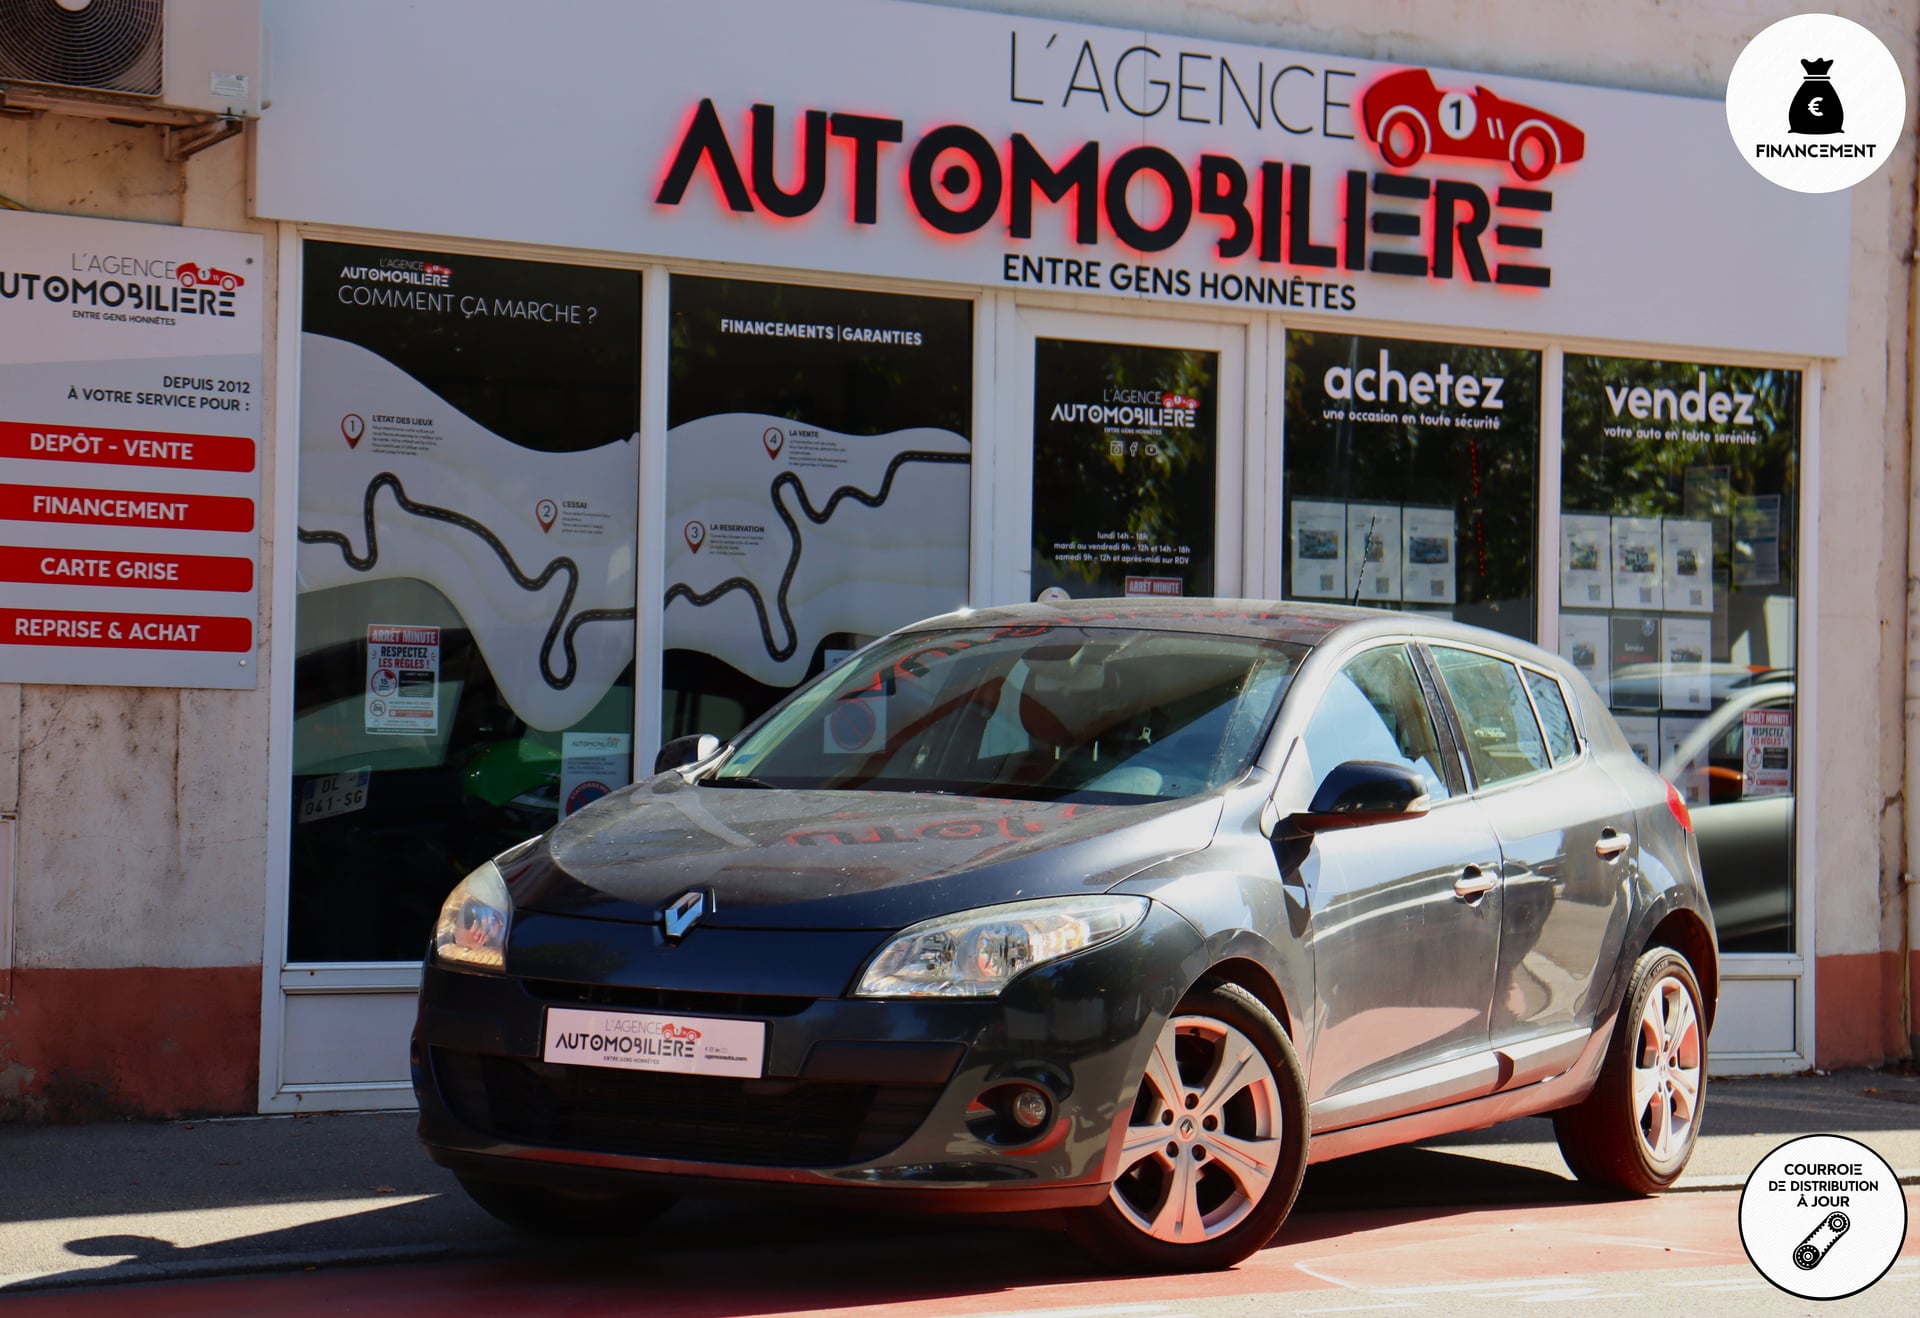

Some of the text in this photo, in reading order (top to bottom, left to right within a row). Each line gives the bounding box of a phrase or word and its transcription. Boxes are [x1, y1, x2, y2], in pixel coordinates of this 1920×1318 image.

[1009, 30, 1357, 140] L'AGENCE
[72, 252, 176, 280] L'AGENCE
[379, 258, 425, 272] L'AGENCE
[1003, 254, 1356, 311] ENTRE GENS HONNÊTES
[0, 271, 236, 317] UTOMOBILIERE
[338, 284, 456, 313] COMMENT
[460, 295, 489, 319] ÇA
[493, 300, 582, 325] MARCHE
[72, 310, 176, 326] ENTRE GENS HONNÊTES
[720, 318, 923, 346] FINANCEMENTS GARANTIES
[163, 375, 251, 394] DEPUIS 2012
[1324, 349, 1504, 409] achetez
[67, 385, 78, 400] À
[82, 387, 132, 403] VOTRE
[136, 392, 196, 408] SERVICE
[200, 397, 240, 411] POUR
[1104, 389, 1162, 405] L'AGENCE
[1605, 371, 1755, 425] vendez
[396, 416, 410, 425] DES
[412, 418, 433, 426] LIEUX
[1323, 409, 1501, 431] une occasion en toute sécurité
[770, 434, 777, 444] 4
[1604, 426, 1633, 439] votre
[1636, 427, 1662, 440] auto
[1665, 430, 1678, 441] en
[1682, 429, 1710, 443] toute
[30, 432, 103, 455] DEPÔT
[123, 438, 193, 460] VENTE
[32, 495, 189, 521] FINANCEMENT
[543, 505, 551, 517] 2
[691, 526, 698, 539] 3
[720, 524, 764, 533] RESERVATION
[1097, 531, 1116, 539] lundi
[1054, 541, 1076, 549] mardi
[1088, 542, 1120, 551] vendredi
[1121, 543, 1131, 551] 9h
[1055, 553, 1082, 561] samedi
[1083, 553, 1093, 561] 9h
[1174, 556, 1190, 565] RDV
[40, 557, 179, 581] CARTE GRISE
[1153, 582, 1180, 593] MINUTE
[15, 617, 201, 643] REPRISE & ACHAT
[403, 631, 436, 643] MINUTE
[381, 646, 428, 658] RESPECTEZ
[378, 658, 393, 667] LES
[605, 1019, 662, 1035] L'AGENCE
